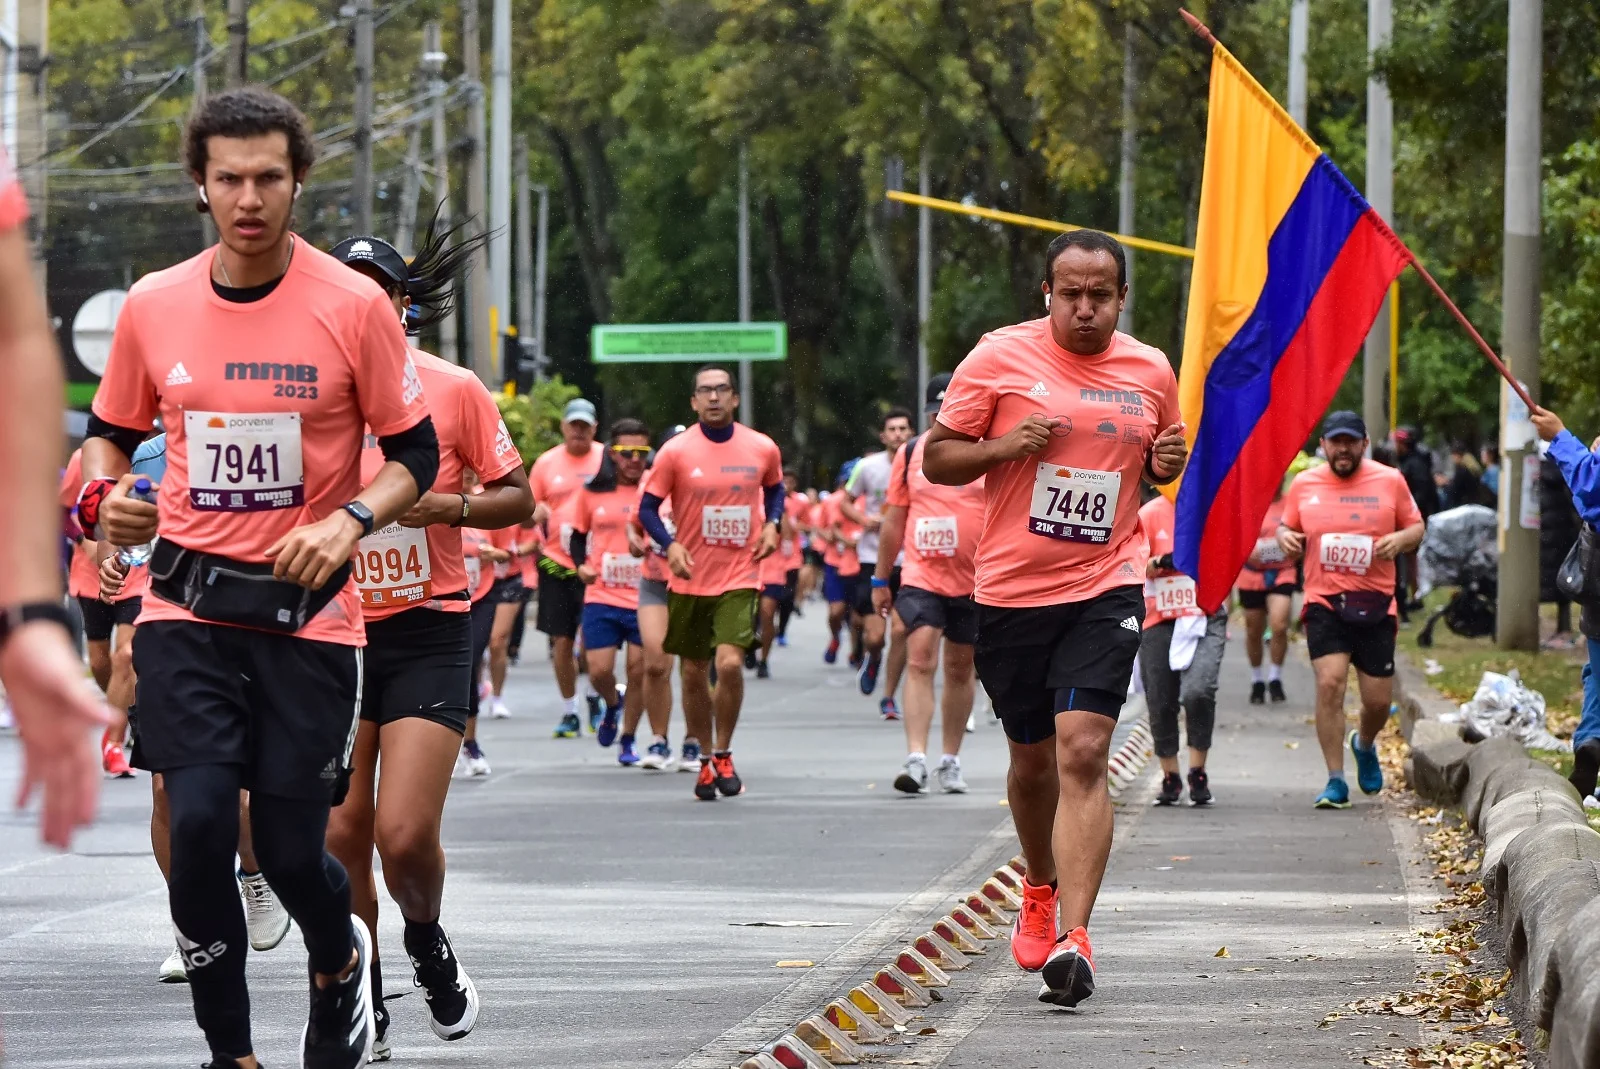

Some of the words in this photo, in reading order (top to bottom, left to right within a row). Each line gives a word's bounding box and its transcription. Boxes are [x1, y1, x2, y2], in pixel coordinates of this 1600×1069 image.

[273, 384, 318, 400] 2023
[1120, 405, 1144, 417] 2023
[230, 418, 275, 429] porvenir
[206, 444, 280, 484] 7941
[1074, 471, 1106, 481] porvenir
[197, 492, 222, 507] 21K
[272, 498, 293, 507] 2023
[1046, 486, 1107, 523] 7448
[707, 519, 748, 536] 13563
[1035, 521, 1056, 534] 21K
[918, 529, 955, 547] 14229
[1326, 546, 1367, 565] 16272
[407, 593, 424, 602] 2023
